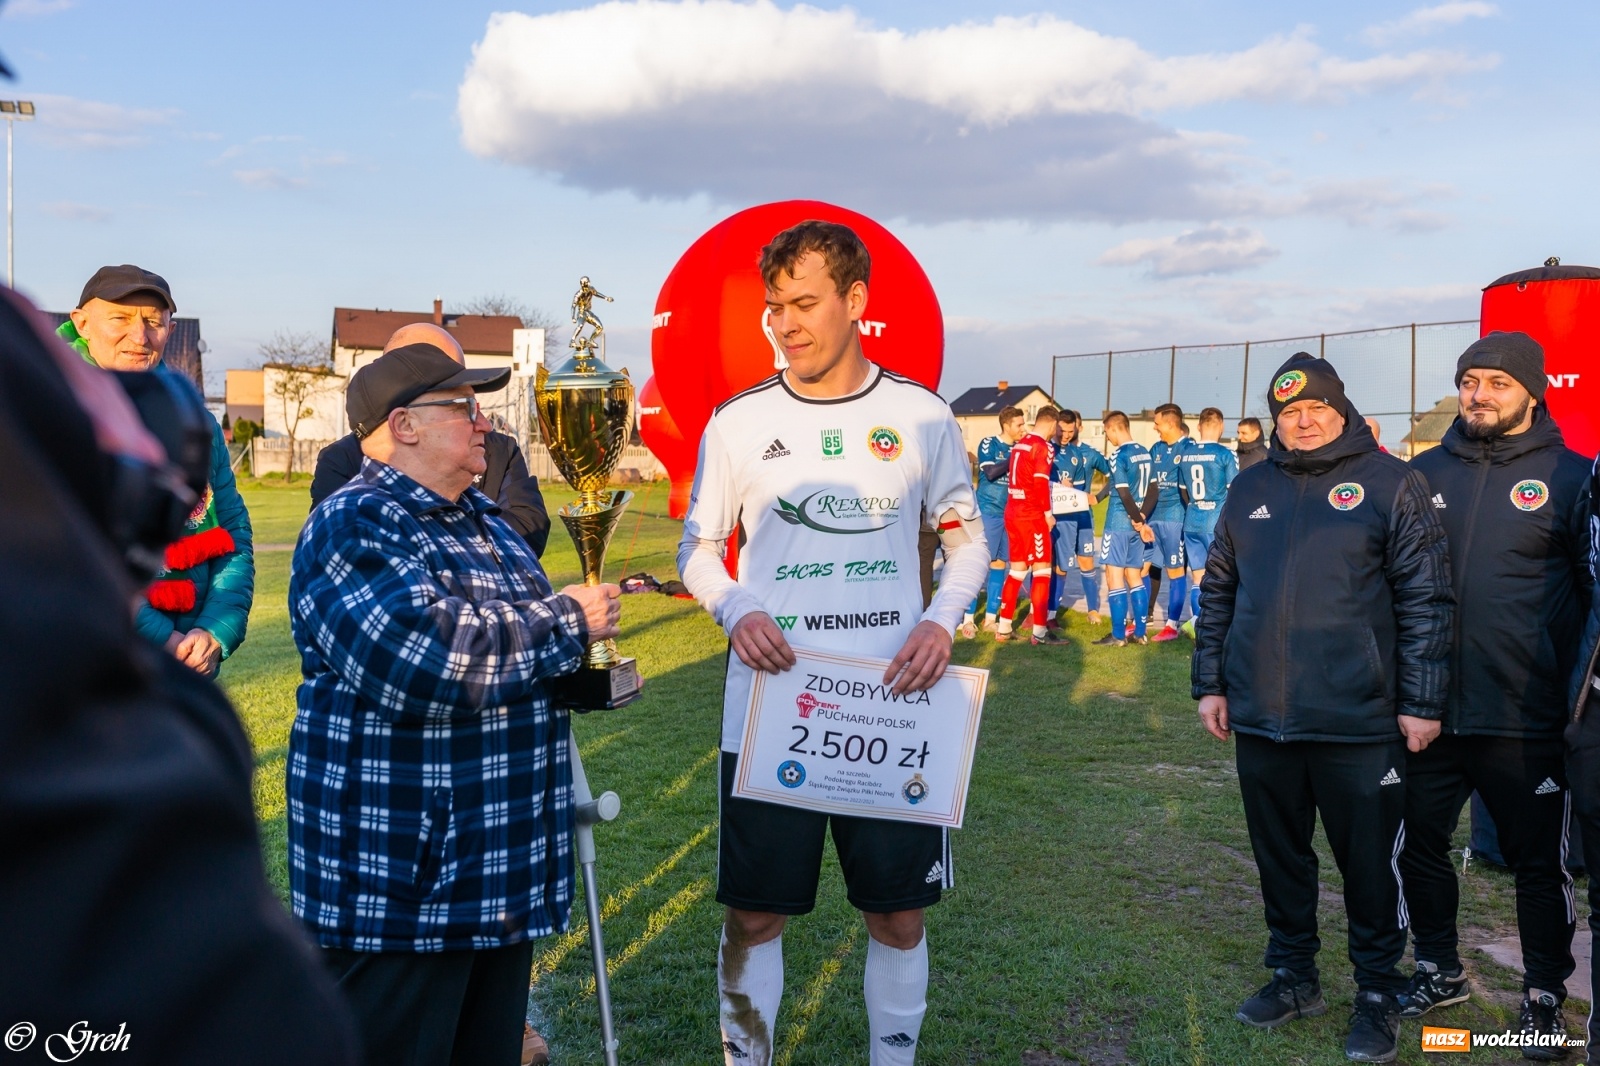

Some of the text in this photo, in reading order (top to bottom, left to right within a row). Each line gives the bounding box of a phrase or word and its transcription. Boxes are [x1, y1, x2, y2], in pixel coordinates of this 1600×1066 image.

[825, 436, 840, 448] BS
[762, 449, 791, 461] adidas
[1012, 452, 1020, 485] 1
[1190, 464, 1206, 500] 8
[817, 495, 900, 519] REKPOL
[1170, 554, 1177, 565] 9
[775, 562, 835, 581] SACHS
[803, 610, 901, 631] WENINGER
[805, 673, 931, 706] ZDOBYWCA
[797, 697, 841, 710] POLTENT
[817, 708, 916, 730] PUCHARU POLSKI
[788, 725, 931, 769] 2.500 zł
[808, 780, 835, 791] Śląskiego
[836, 785, 861, 794] Związku
[824, 775, 882, 788] Podokręgu Racibórz
[1380, 777, 1401, 786] adidas
[1535, 785, 1560, 795] adidas
[880, 1035, 915, 1048] adidas
